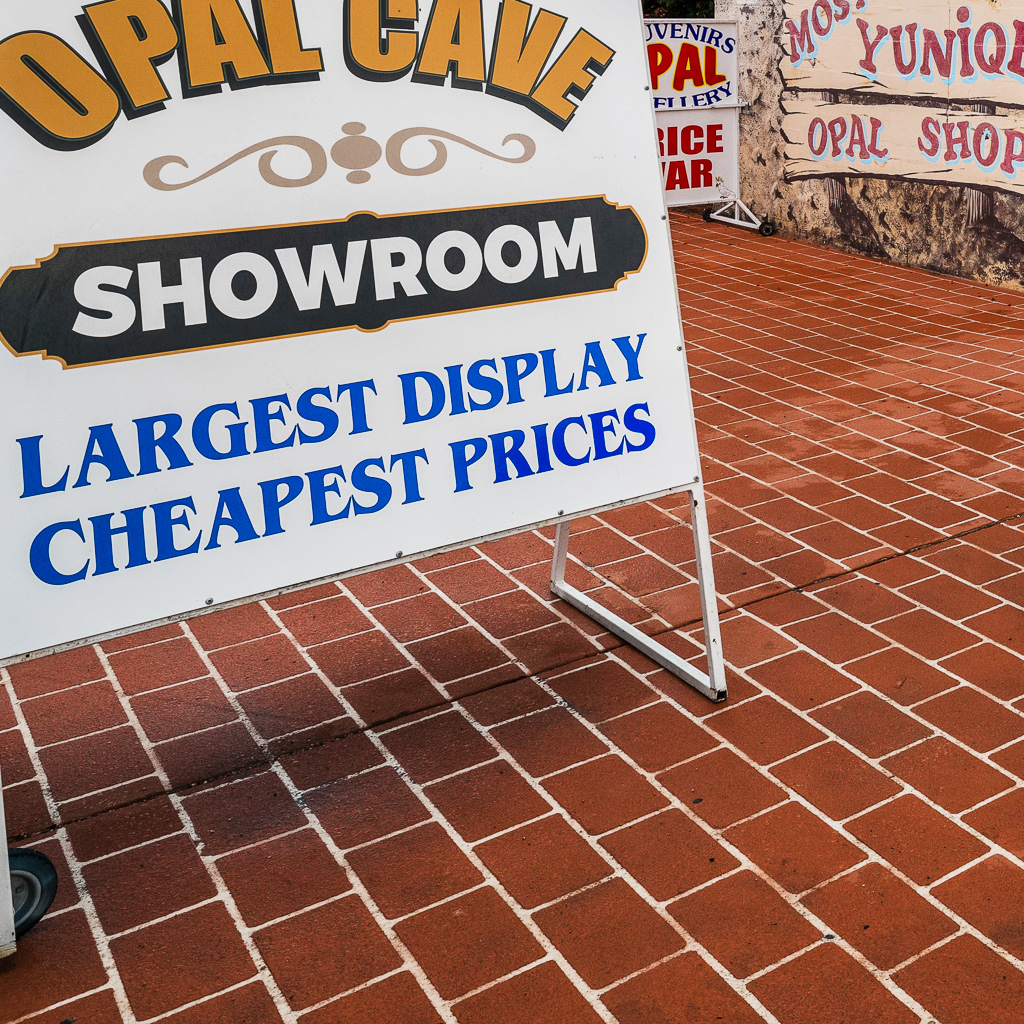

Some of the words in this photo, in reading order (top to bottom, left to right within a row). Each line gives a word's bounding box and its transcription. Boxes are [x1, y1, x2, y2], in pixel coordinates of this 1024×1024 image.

[646, 22, 736, 54] VENIRS
[646, 42, 728, 92] PAL
[808, 114, 889, 162] OPAL
[661, 159, 713, 191] AR
[72, 216, 598, 338] SHOWROOM
[16, 378, 378, 499] LARGEST
[399, 333, 648, 425] DISPLAY
[29, 448, 430, 587] CHEAPEST
[449, 401, 657, 494] PRICES
